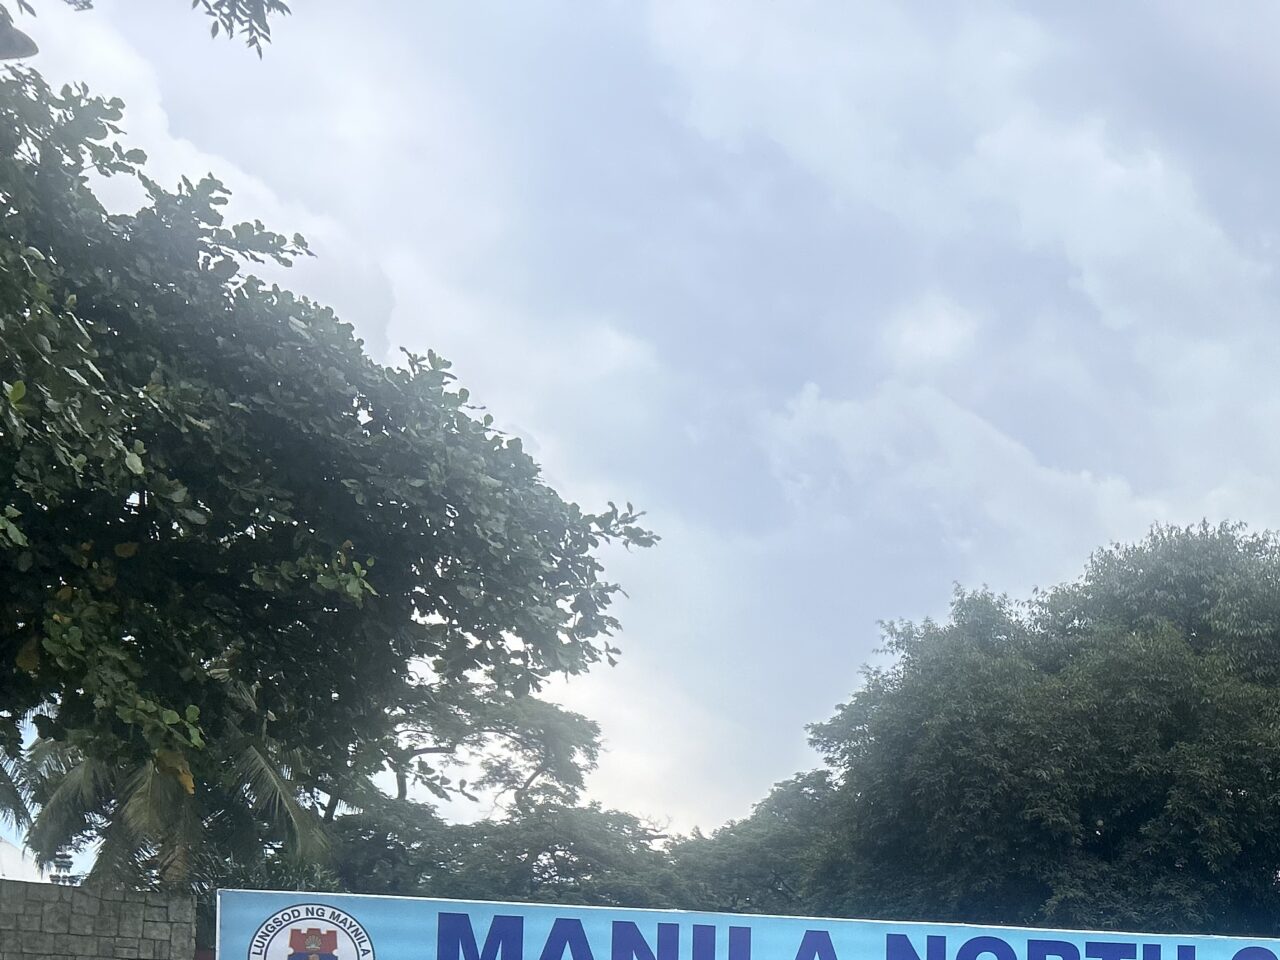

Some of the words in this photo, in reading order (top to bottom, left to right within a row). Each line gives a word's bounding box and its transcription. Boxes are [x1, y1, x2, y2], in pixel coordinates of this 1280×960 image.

[252, 908, 301, 956] LUNGSOD
[305, 907, 326, 918] NG
[329, 911, 371, 957] MAYNILA
